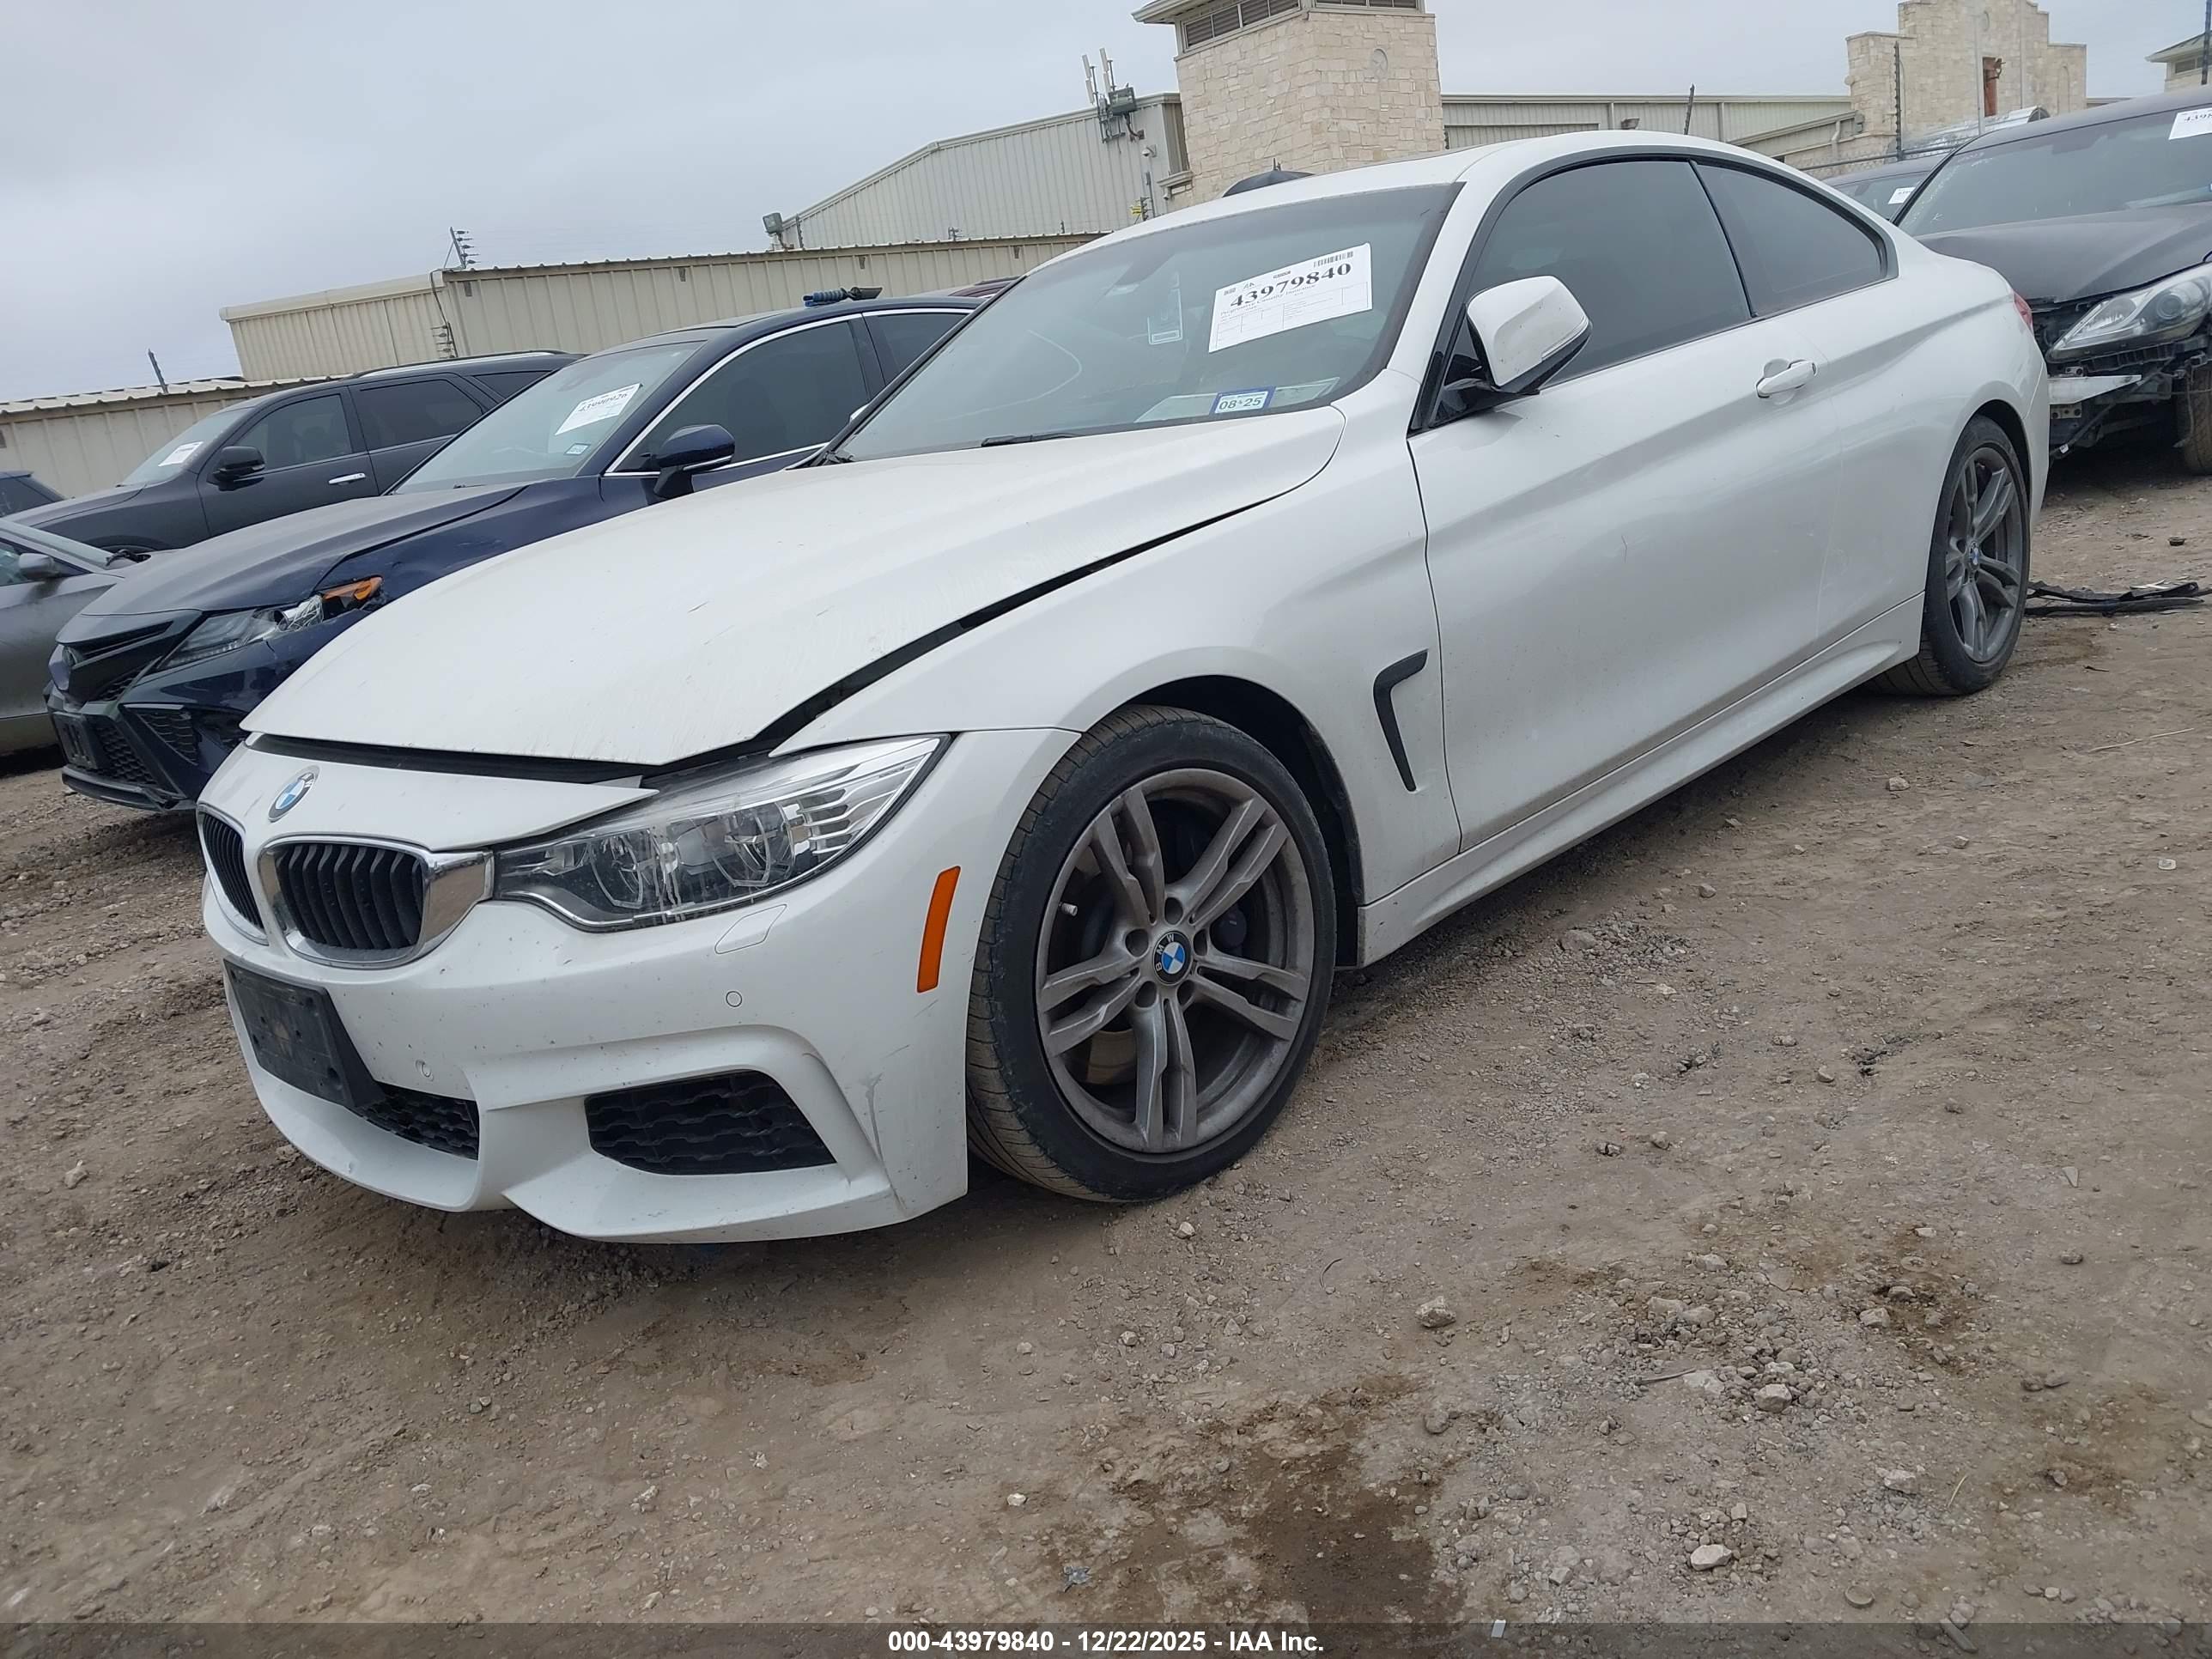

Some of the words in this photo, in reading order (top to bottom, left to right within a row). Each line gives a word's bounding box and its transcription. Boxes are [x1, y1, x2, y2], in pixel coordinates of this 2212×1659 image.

[1231, 263, 1352, 307] 43979840
[1218, 399, 1237, 410] 08
[1243, 397, 1263, 407] 25
[1155, 933, 1175, 971] BMW
